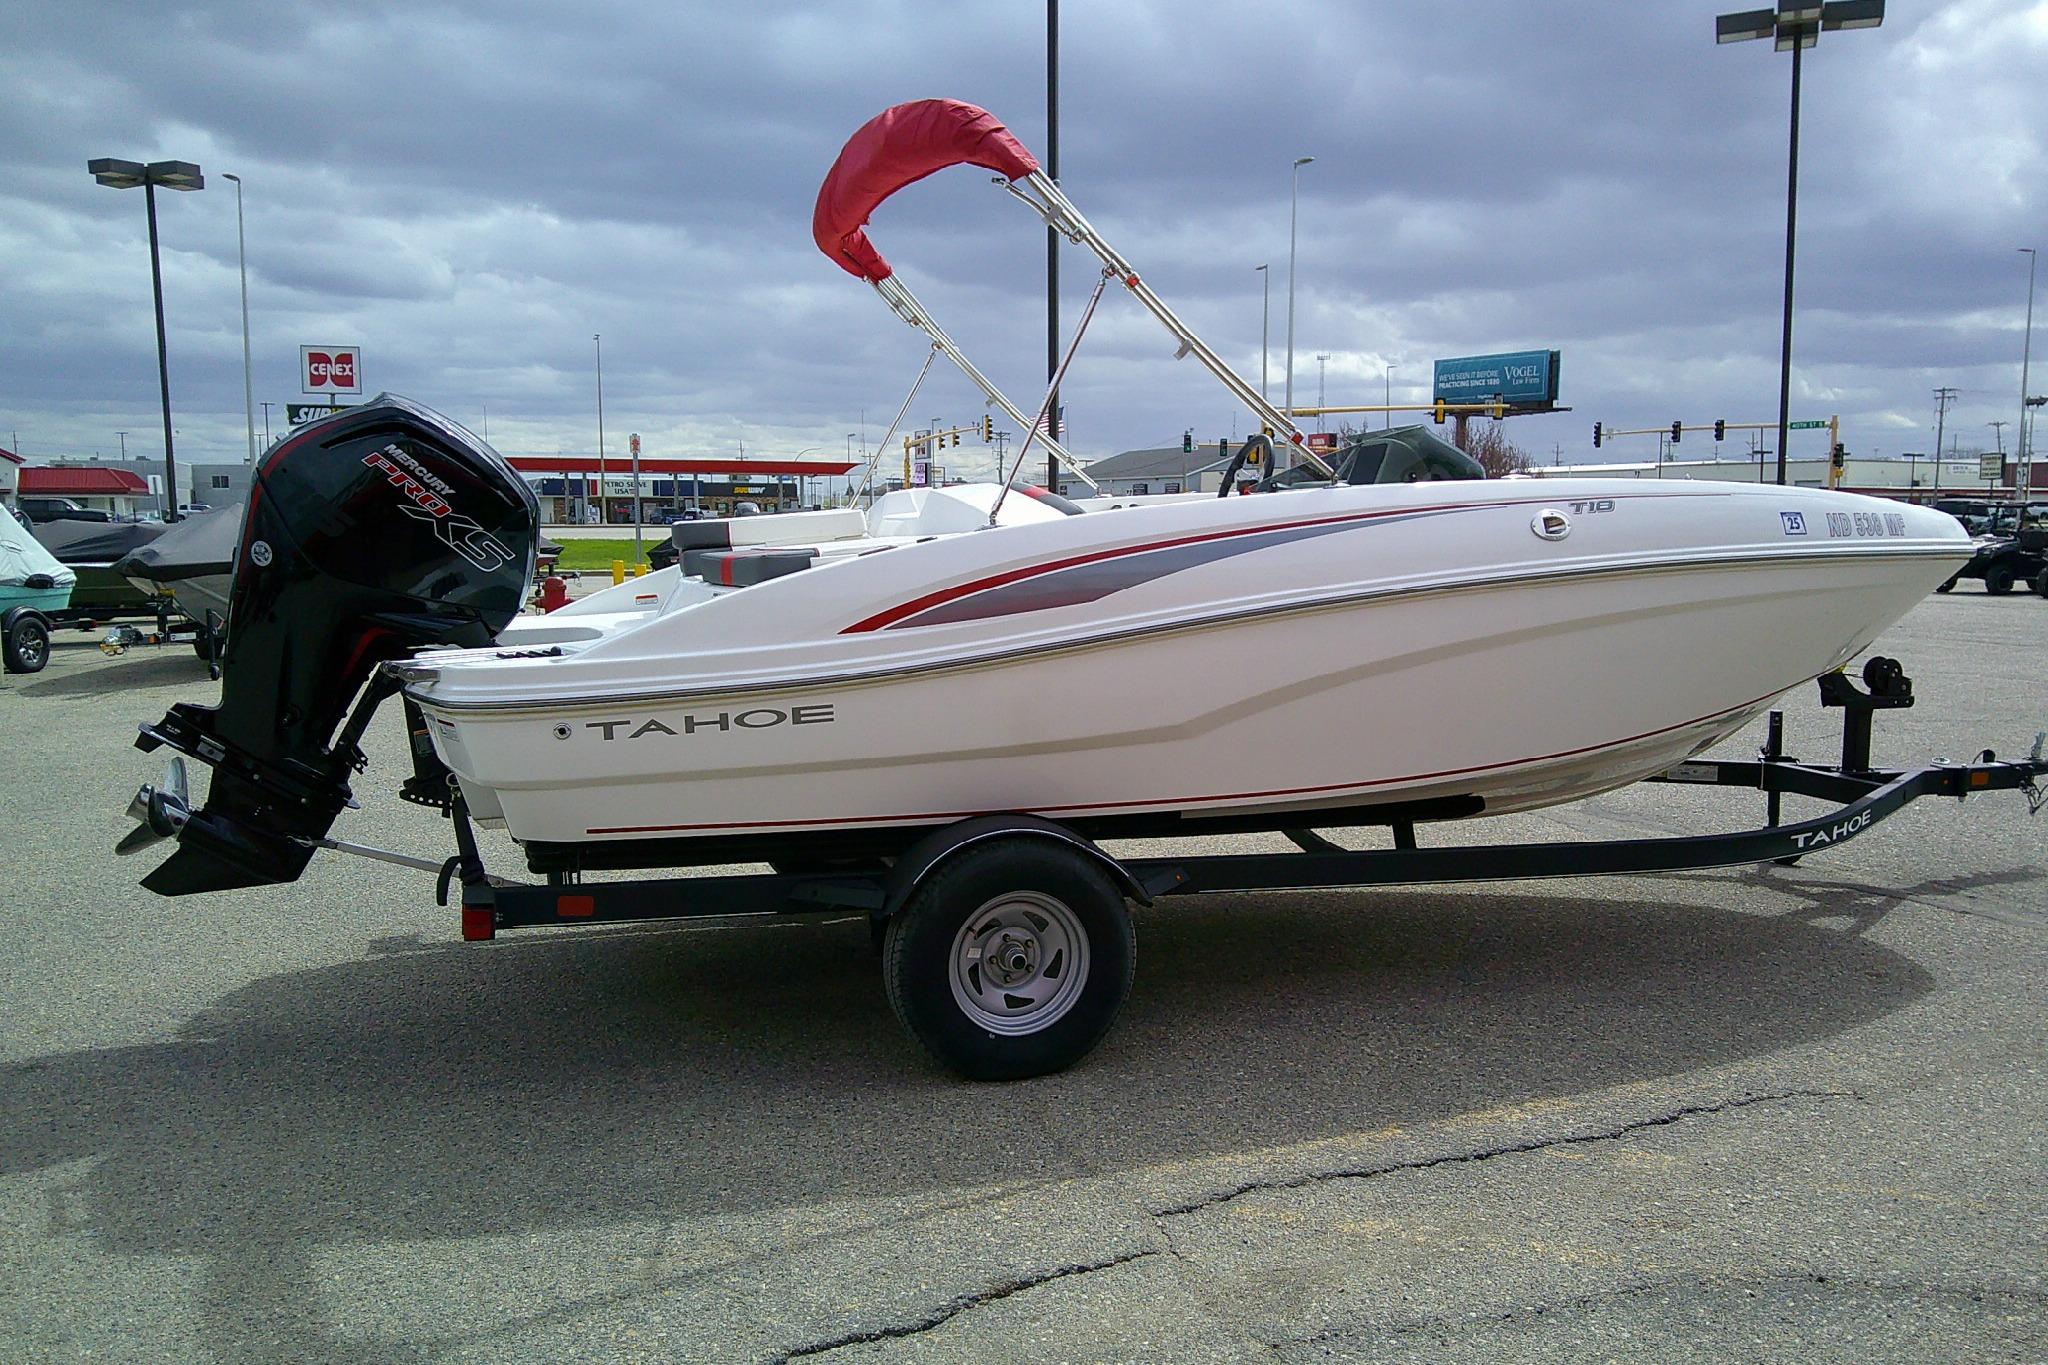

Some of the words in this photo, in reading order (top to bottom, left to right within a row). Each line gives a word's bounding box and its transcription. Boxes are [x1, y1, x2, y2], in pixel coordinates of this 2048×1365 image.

[310, 363, 353, 376] CENEX
[1504, 365, 1540, 380] VOGEL
[384, 443, 456, 495] MERCURY
[361, 452, 452, 518] PRO
[1569, 500, 1616, 514] T18
[397, 489, 516, 572] XS
[1787, 517, 1801, 530] 25
[1826, 512, 1852, 537] ND
[586, 704, 834, 740] TAHOE
[1790, 809, 1871, 848] TAHOE
